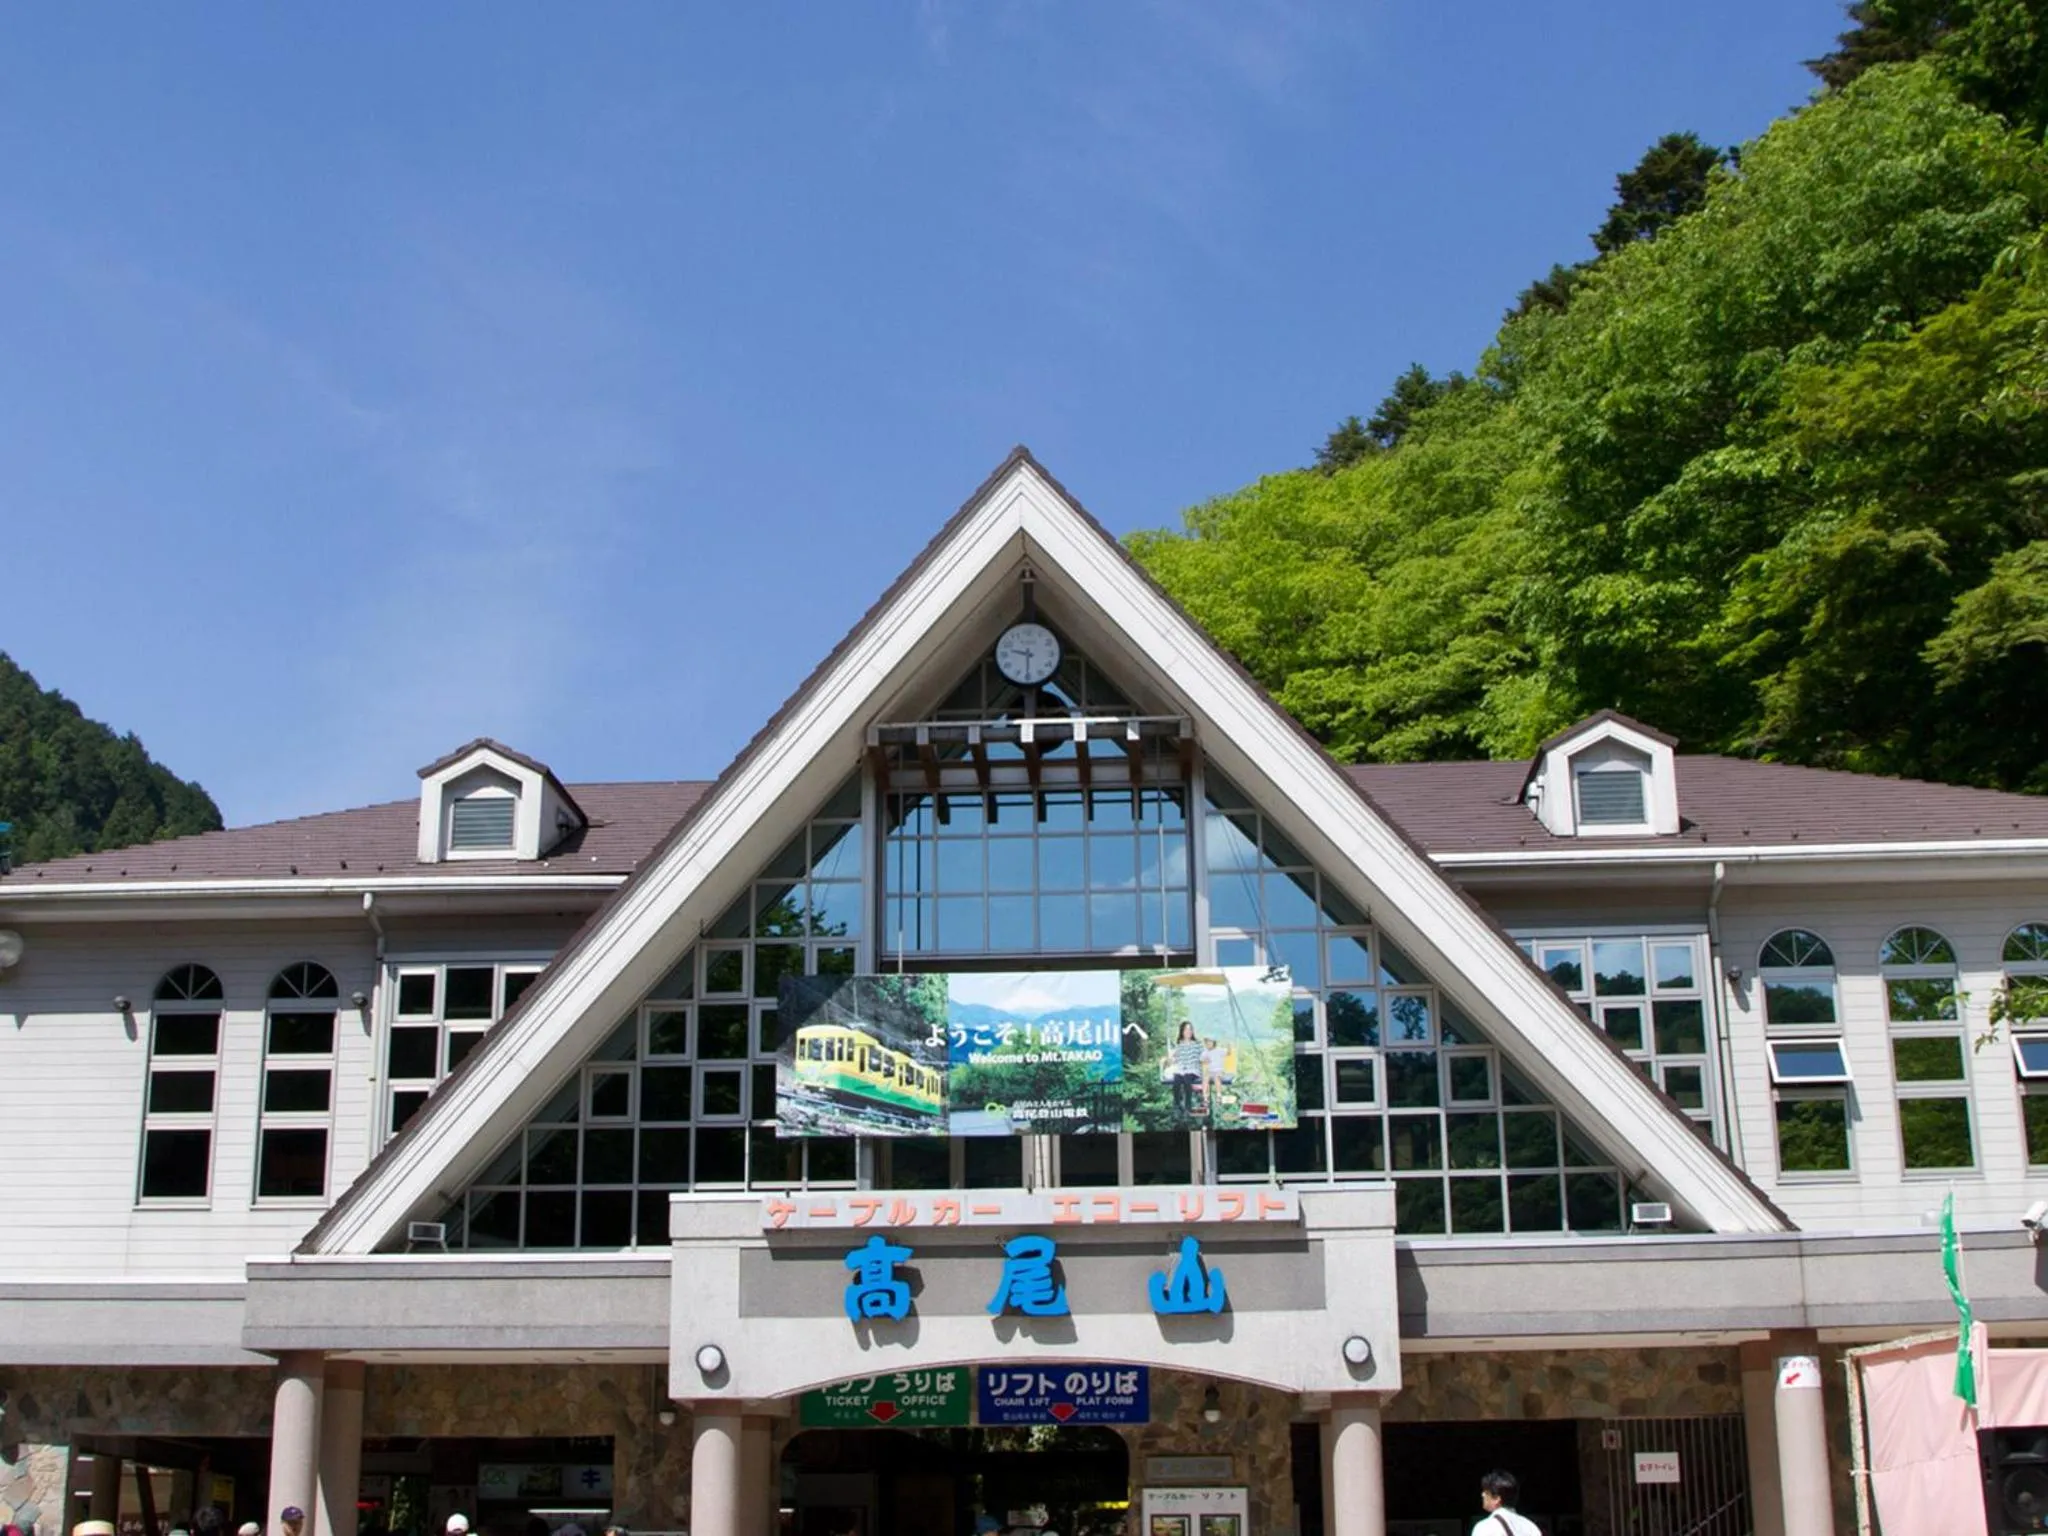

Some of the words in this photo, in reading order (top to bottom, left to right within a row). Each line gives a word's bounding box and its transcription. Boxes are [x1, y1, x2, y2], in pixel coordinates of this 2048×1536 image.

[968, 1051, 1023, 1064] Welcome
[1026, 1051, 1039, 1063] to
[767, 1196, 1001, 1228] ケーブルカー
[893, 1372, 956, 1393] うりば
[988, 1373, 1057, 1396] リフト
[1064, 1371, 1139, 1396] のりば
[825, 1395, 870, 1407] TICKET
[901, 1395, 947, 1406] OFFICE
[994, 1397, 1025, 1406] CHAIR
[1029, 1397, 1051, 1406] LIFT
[1105, 1397, 1134, 1406] FORM
